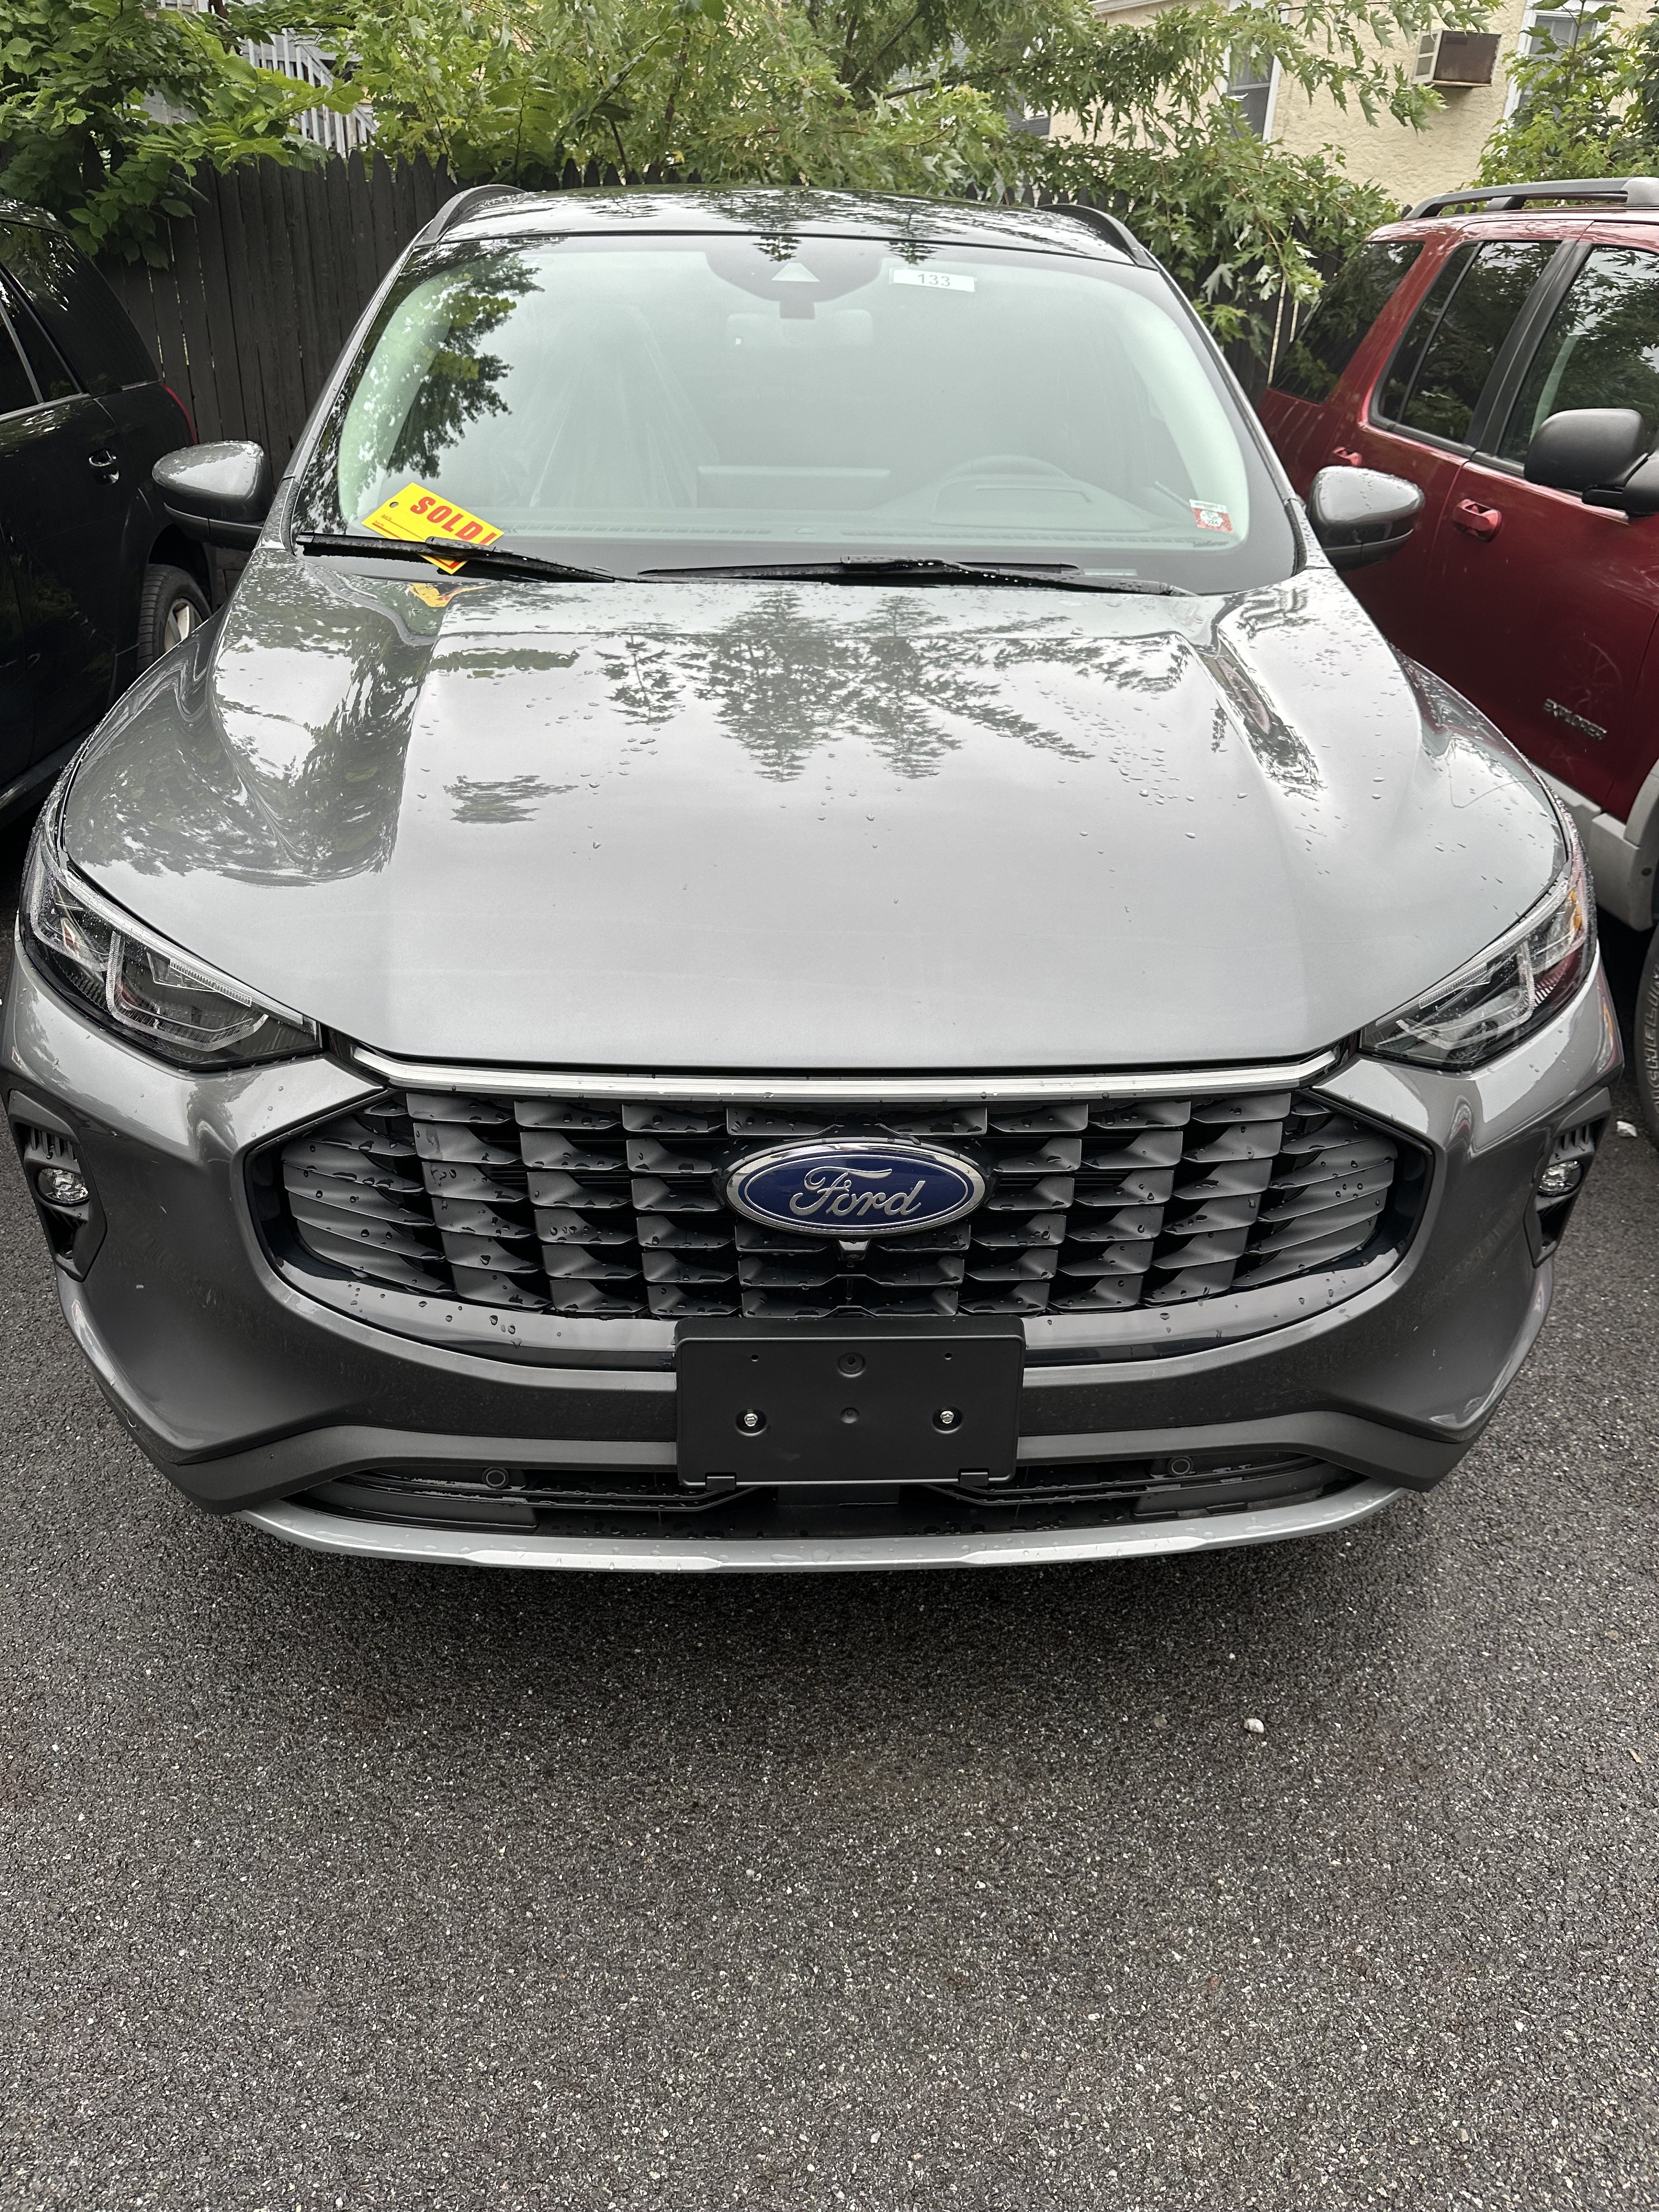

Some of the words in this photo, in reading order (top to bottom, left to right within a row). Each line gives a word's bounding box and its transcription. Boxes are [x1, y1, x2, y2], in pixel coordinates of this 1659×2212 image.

[917, 273, 951, 287] 133
[1544, 698, 1608, 740] EXPLORER
[789, 1165, 926, 1217] Ford
